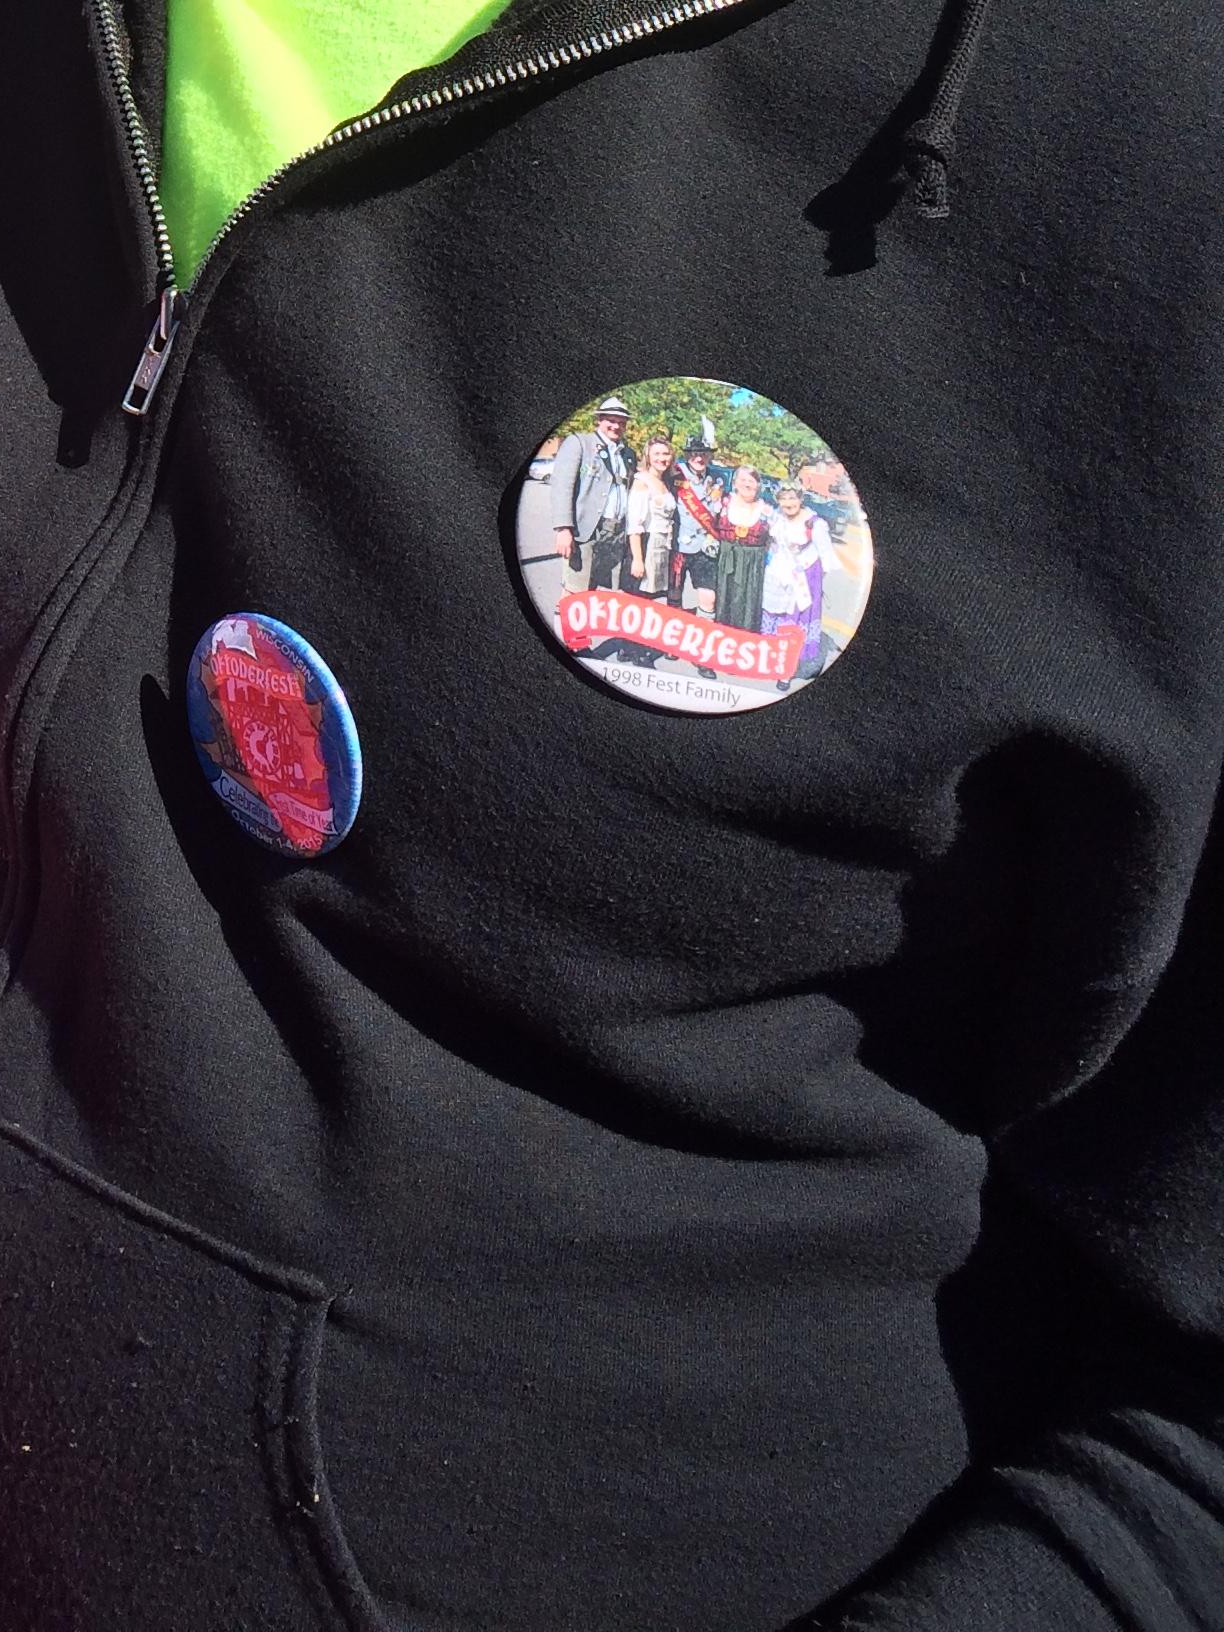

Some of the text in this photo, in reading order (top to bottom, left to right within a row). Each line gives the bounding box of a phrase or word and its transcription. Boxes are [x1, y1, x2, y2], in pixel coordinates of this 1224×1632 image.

[255, 629, 314, 684] WISCONSIN
[603, 666, 742, 708] 1998 Fest Family
[231, 808, 274, 845] October
[297, 832, 323, 851] 2015
